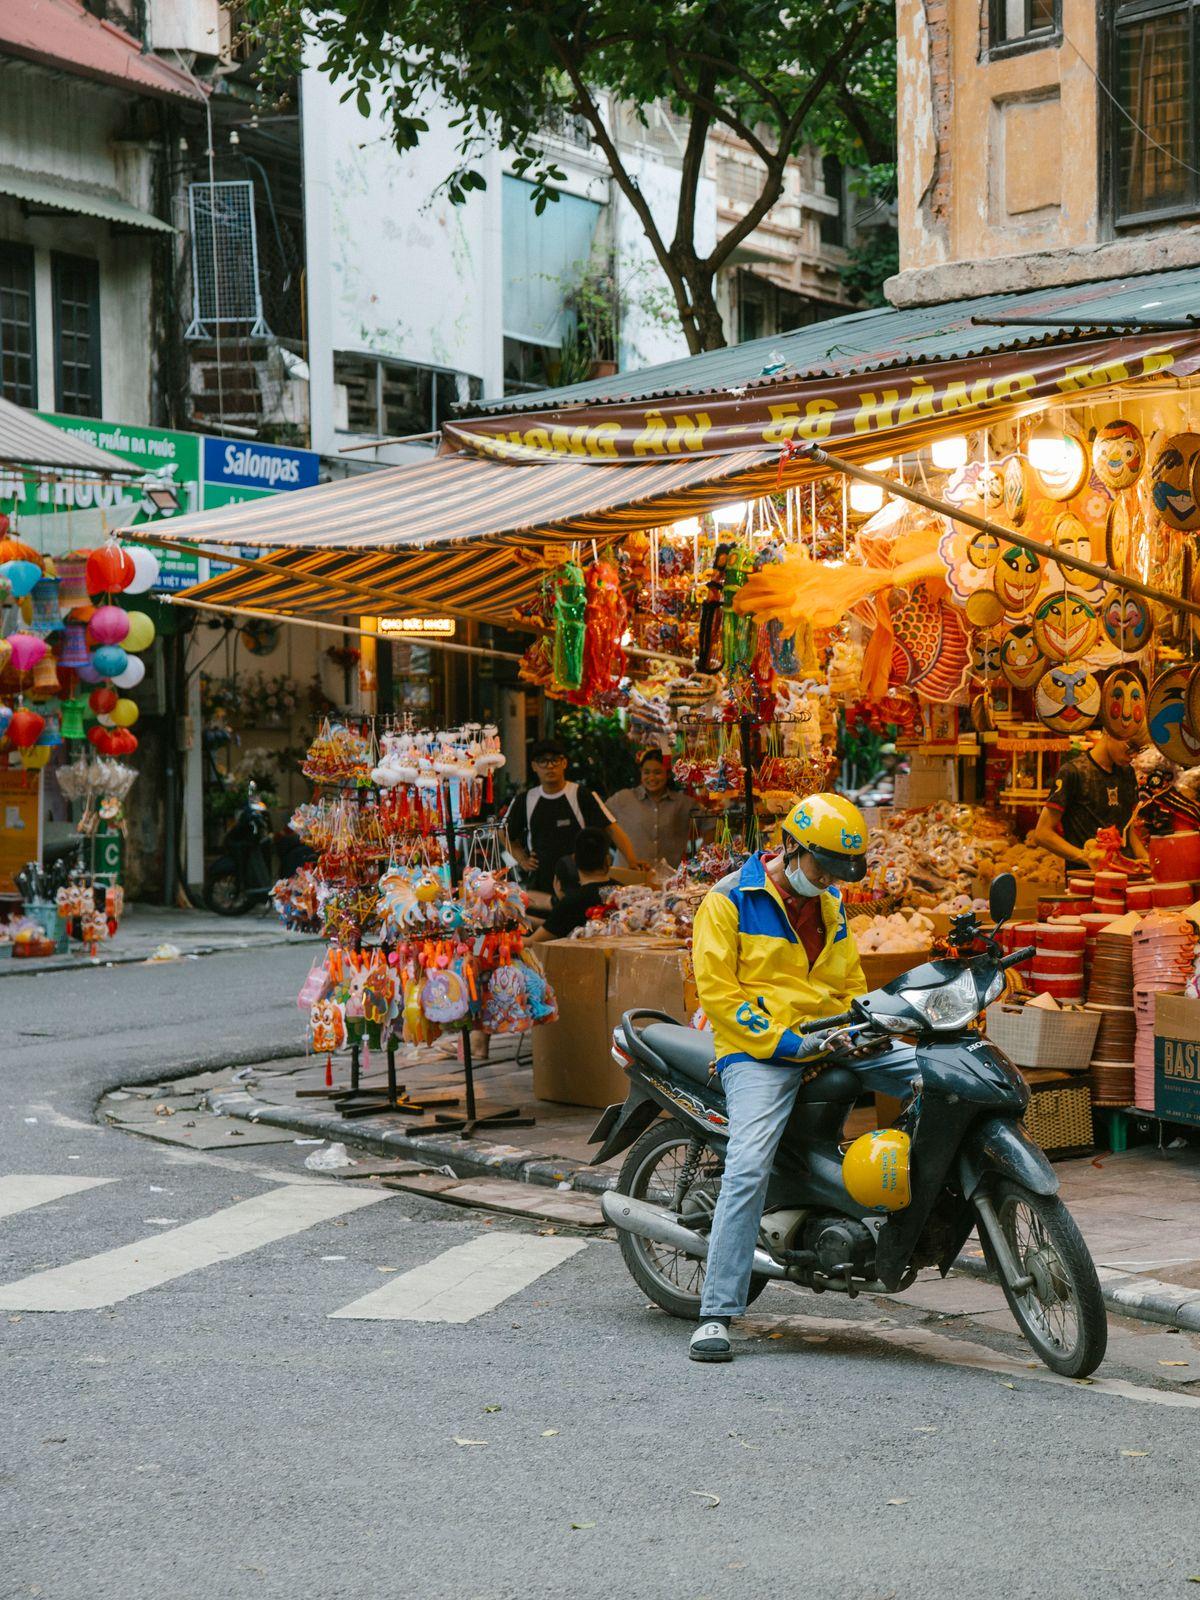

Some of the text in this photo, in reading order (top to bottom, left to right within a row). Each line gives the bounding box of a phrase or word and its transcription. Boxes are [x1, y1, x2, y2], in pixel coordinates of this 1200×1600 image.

[633, 408, 713, 454] ÂN
[762, 399, 839, 444] 56
[855, 374, 1037, 436] HÀNG
[222, 443, 300, 485] Salonpas
[841, 828, 862, 849] be
[736, 1001, 769, 1034] be
